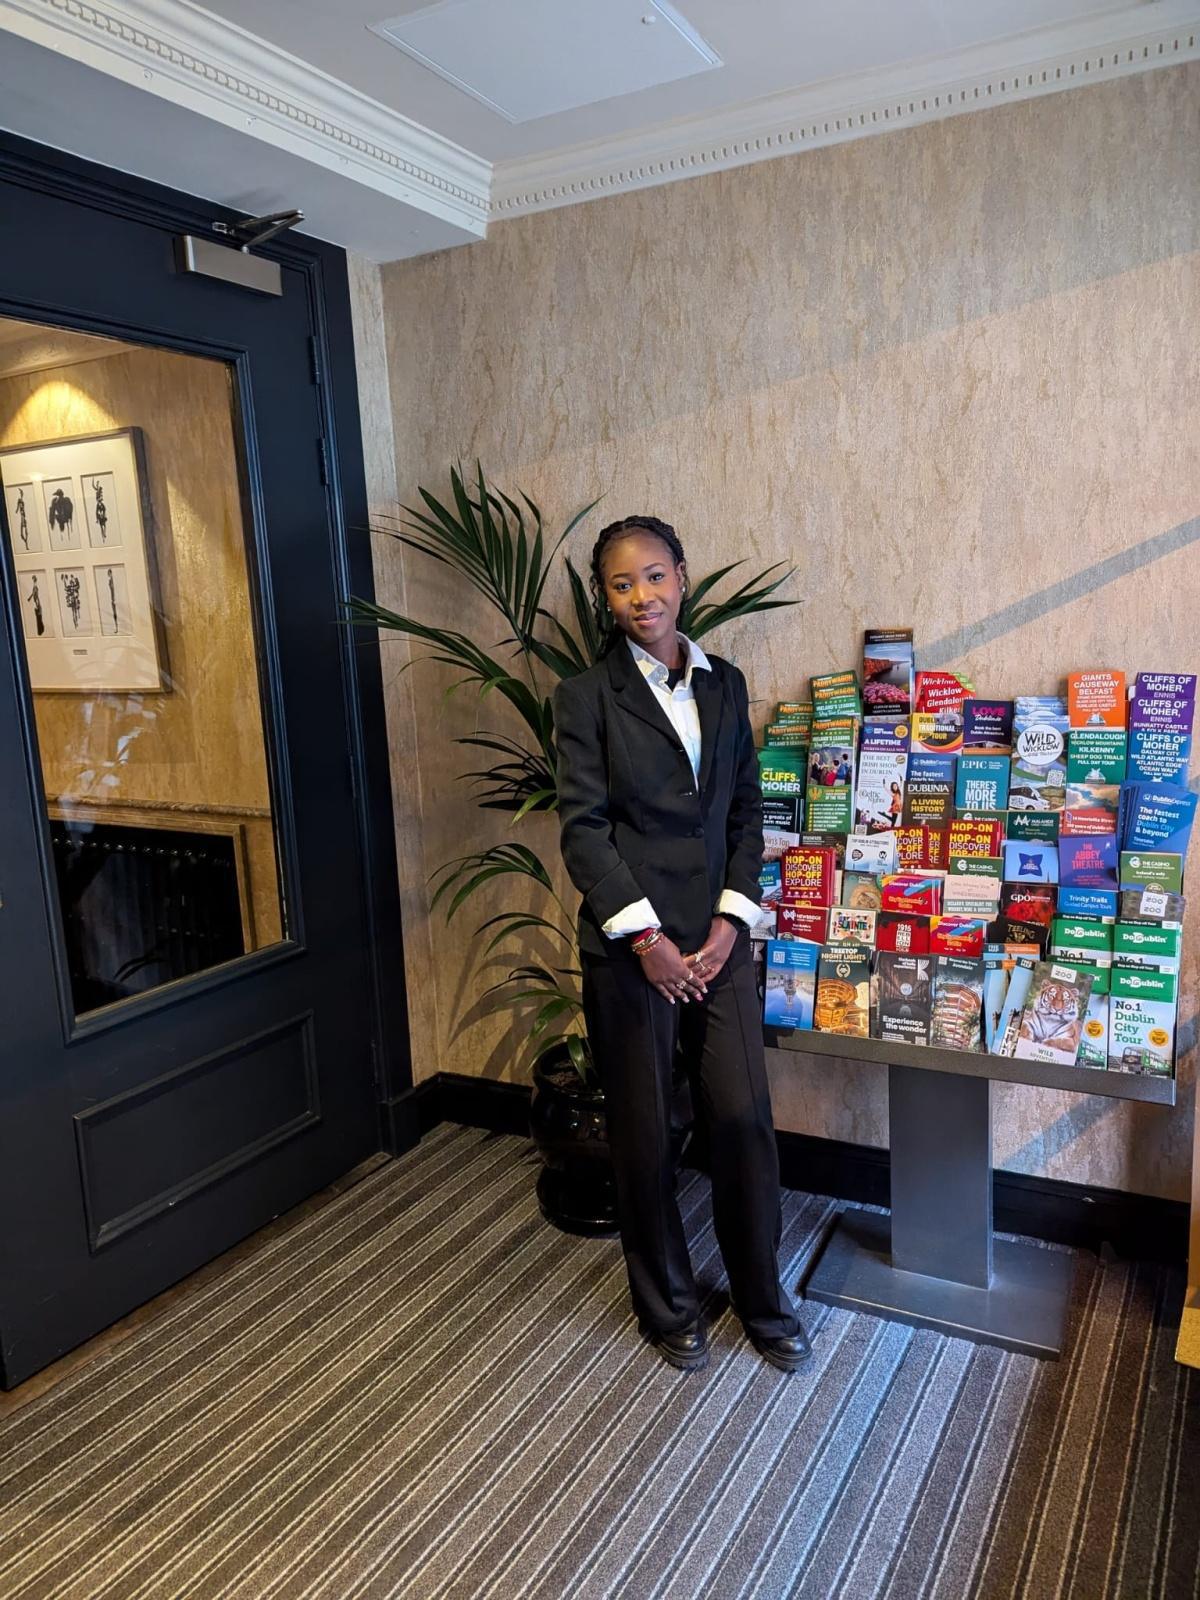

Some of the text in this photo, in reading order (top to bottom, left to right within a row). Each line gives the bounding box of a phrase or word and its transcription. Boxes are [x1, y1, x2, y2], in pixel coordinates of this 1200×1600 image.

[1080, 673, 1112, 682] GIANTS
[1142, 674, 1193, 685] CLIFFS OF
[1073, 680, 1120, 689] CAUSEWAY
[928, 687, 963, 698] Wicklow
[1078, 688, 1114, 696] BELFAST
[1137, 698, 1189, 709] CLIFFS OF
[1142, 706, 1181, 717] MOHER,
[1070, 732, 1126, 741] GLENDALOUGH
[1136, 733, 1188, 744] CLIFFS OF
[875, 738, 903, 746] LIFETIME
[1142, 741, 1179, 751] MOHER
[1079, 746, 1116, 754] KILKENNY
[962, 760, 988, 770] EPIC
[762, 771, 797, 783] CLIFFS
[911, 770, 945, 779] The fastest
[761, 781, 801, 792] MOHER
[907, 783, 950, 793] DUBLINIA
[966, 780, 997, 791] THERE'S
[965, 789, 997, 802] MORE
[911, 798, 919, 806] A
[911, 805, 945, 813] HISTORY
[1139, 805, 1180, 819] The fastest
[1137, 814, 1157, 823] coach
[952, 822, 994, 832] HOP-ON
[1136, 820, 1175, 833] Dublin City
[949, 832, 991, 844] HOP-ON
[1142, 828, 1169, 839] beyond
[897, 837, 924, 846] COVER
[949, 842, 991, 851] DISCOVER
[1074, 849, 1101, 859] ABBEY
[784, 855, 823, 865] HOP-ON
[1071, 859, 1105, 870] THEATRE
[784, 864, 823, 872] DISCOVER
[784, 871, 822, 880] HOP-OFF
[784, 878, 822, 887] EXPLORE
[1069, 894, 1108, 904] Trinity Trails
[1080, 901, 1099, 911] Campus
[821, 953, 844, 961] NIGHT
[1114, 1000, 1142, 1011] No.1
[882, 1015, 924, 1027] Experience
[1114, 1011, 1156, 1024] Dublin
[885, 1022, 927, 1034] the wonder
[1113, 1022, 1140, 1035] City
[1114, 1033, 1144, 1045] Tour
